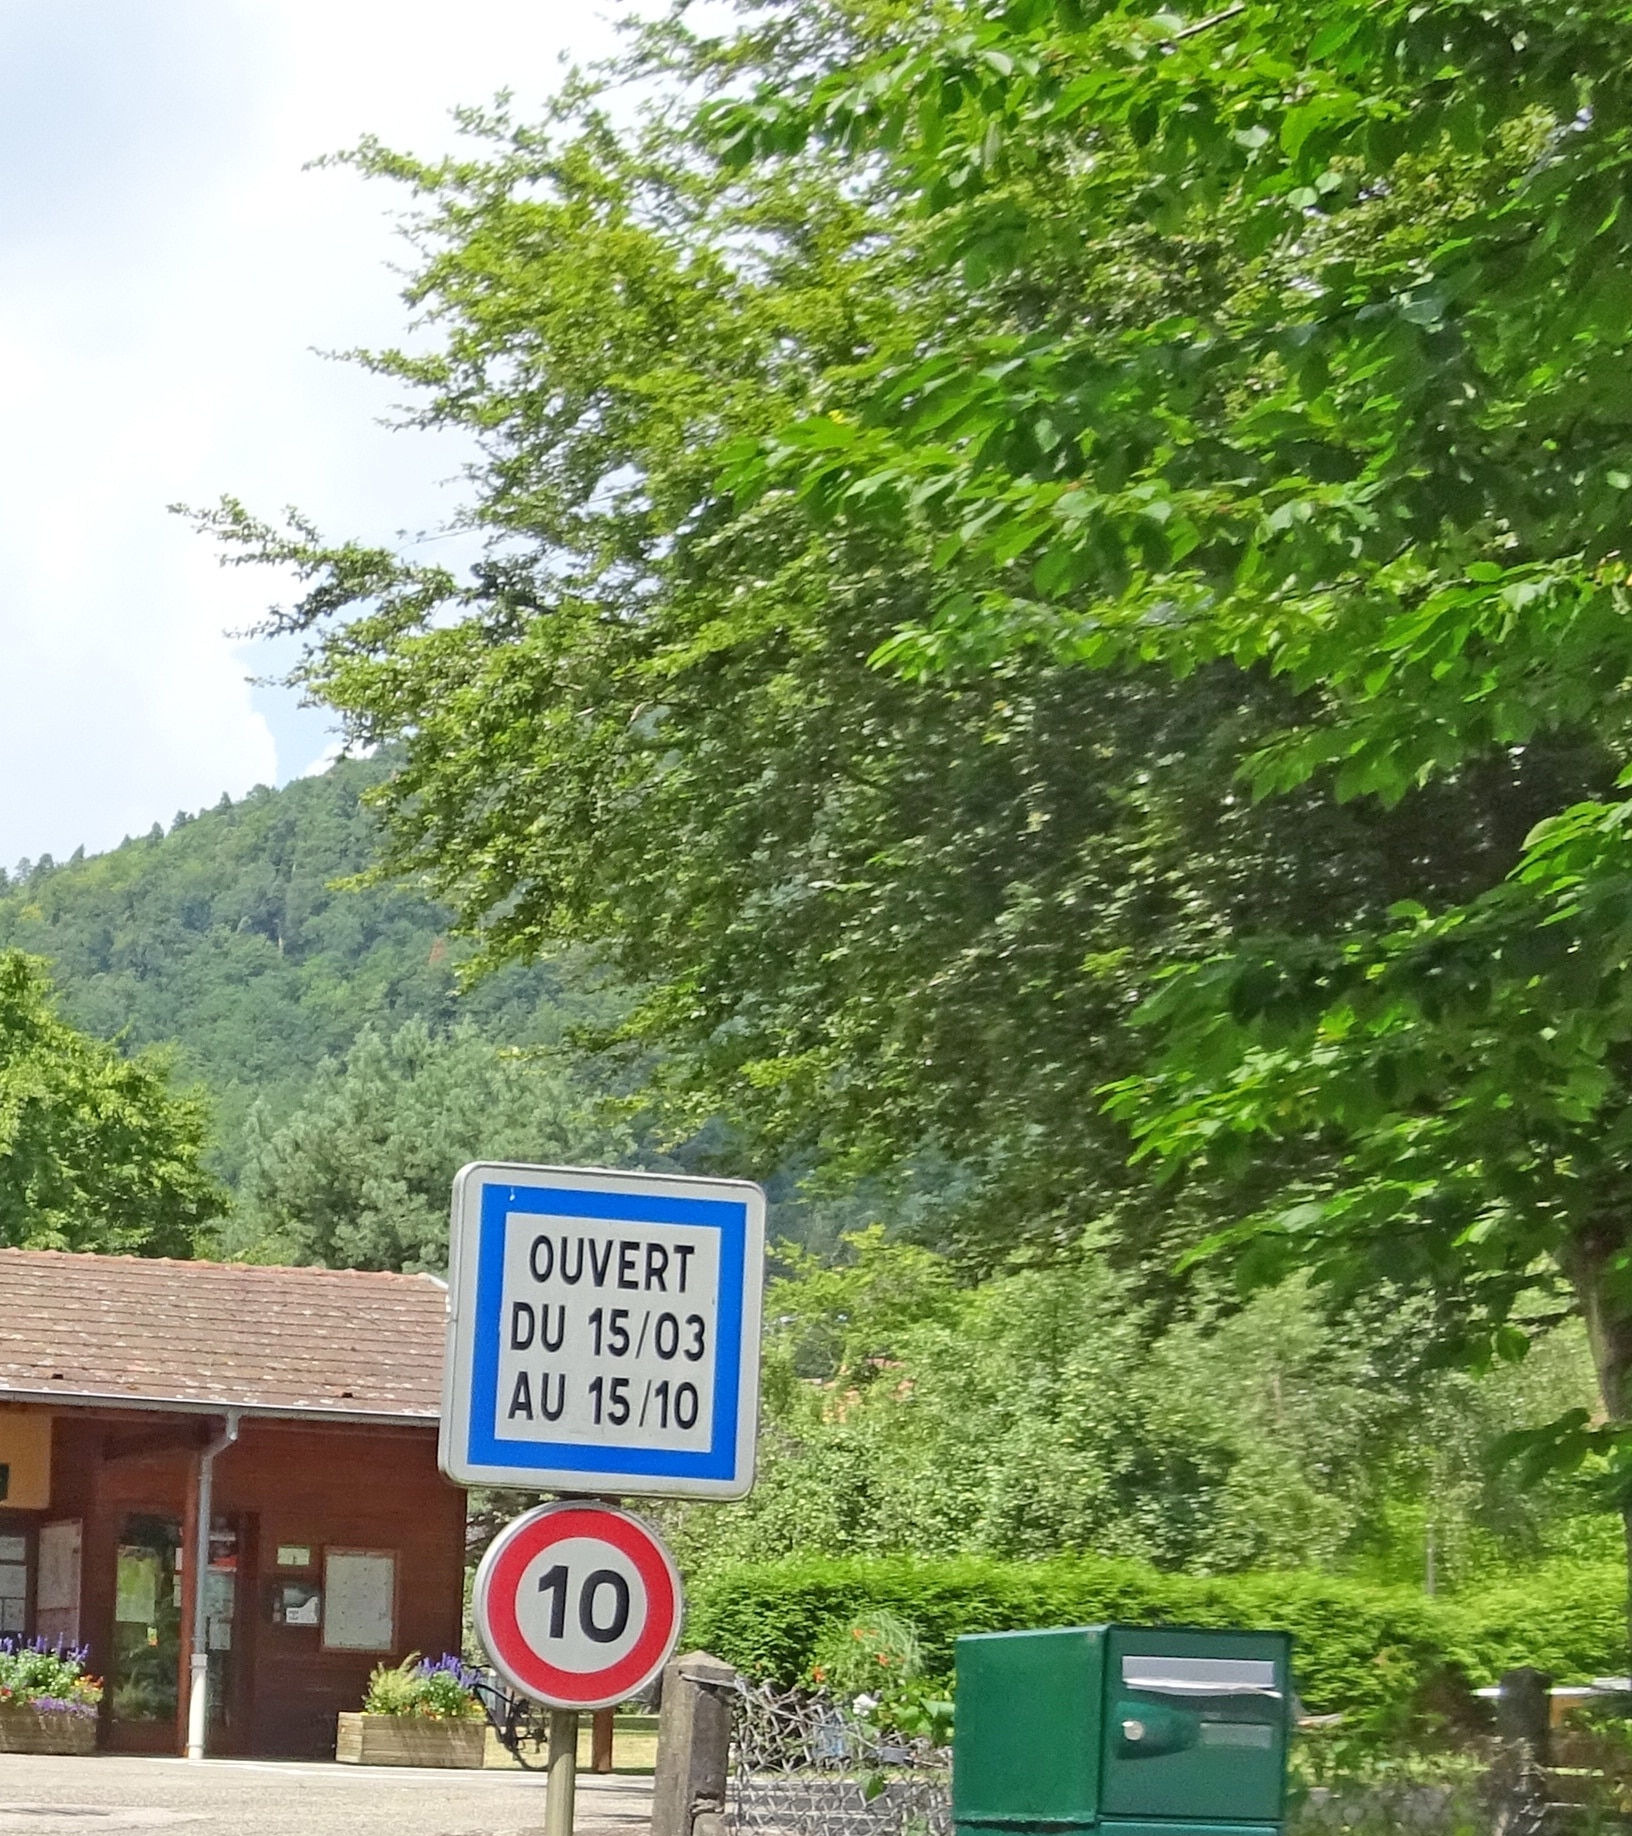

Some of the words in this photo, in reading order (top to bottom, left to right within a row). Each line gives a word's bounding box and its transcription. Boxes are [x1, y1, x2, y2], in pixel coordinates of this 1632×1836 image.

[529, 1235, 696, 1293] OUVERT
[511, 1301, 566, 1353] DU
[588, 1307, 706, 1363] 15/03
[507, 1371, 567, 1423] AU
[588, 1376, 700, 1431] 15/10
[537, 1565, 631, 1645] 10
